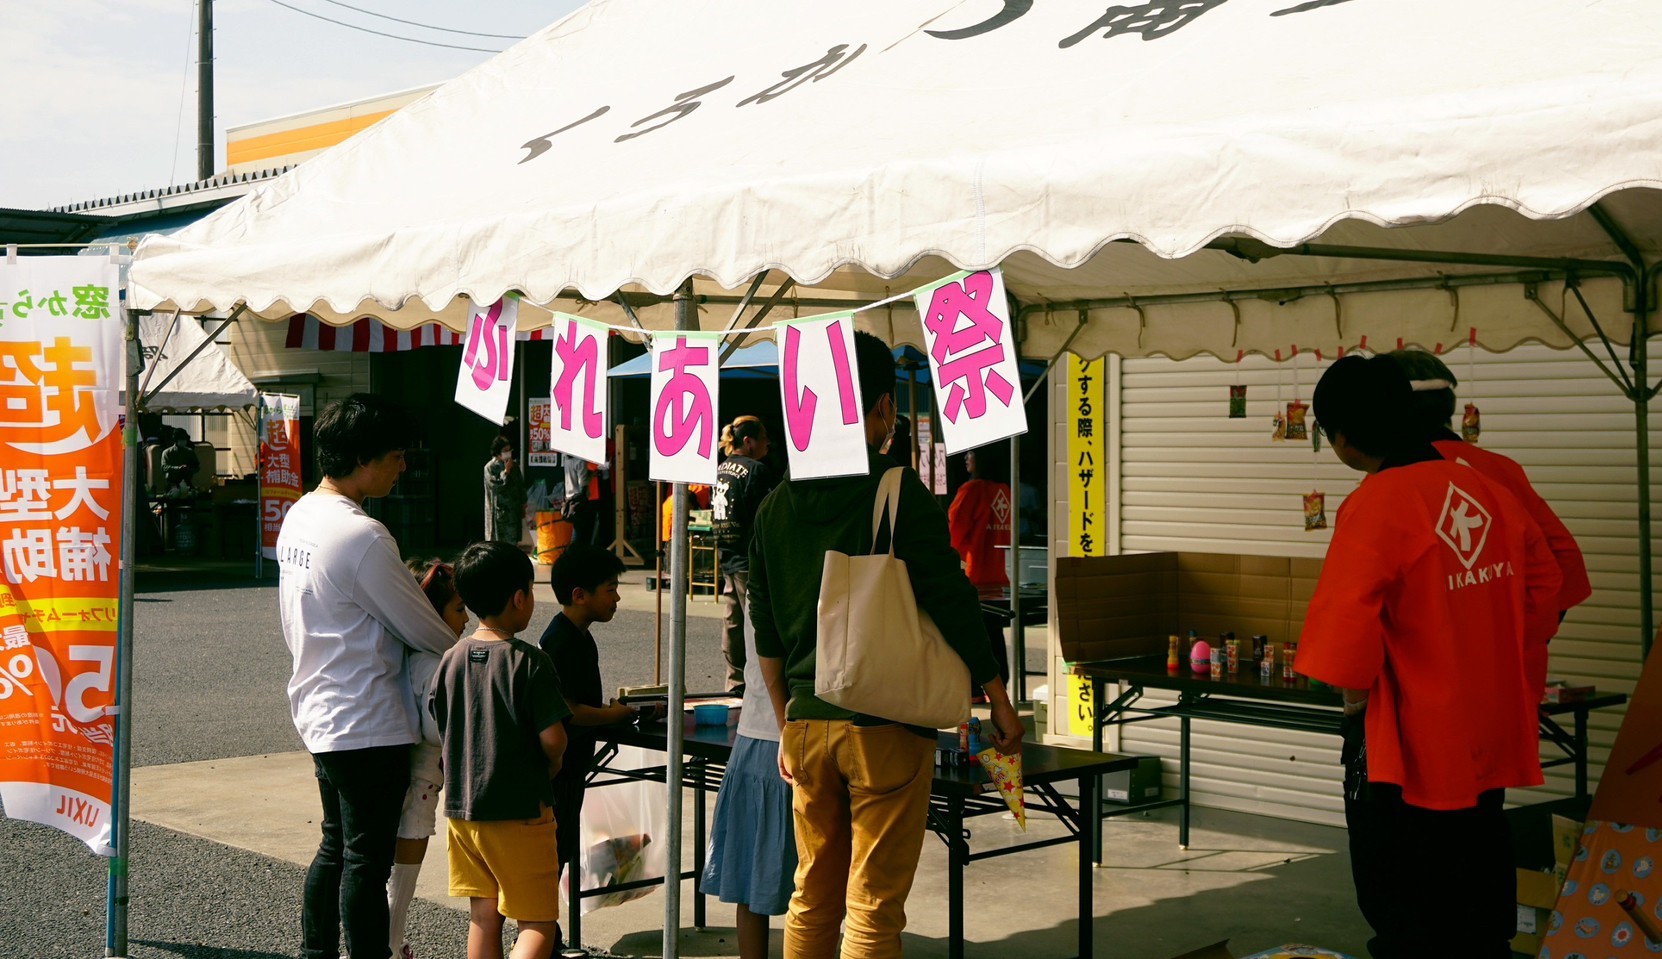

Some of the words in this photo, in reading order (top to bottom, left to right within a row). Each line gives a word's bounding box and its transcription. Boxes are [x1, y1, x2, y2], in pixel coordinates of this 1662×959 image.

[464, 270, 1014, 460] ふれあい祭
[267, 419, 288, 450] 超
[268, 453, 290, 469] 大型
[1078, 358, 1095, 558] する際、ハザードを
[266, 469, 299, 488] 補助金
[280, 546, 310, 570] LARGE
[1078, 674, 1093, 731] さい。
